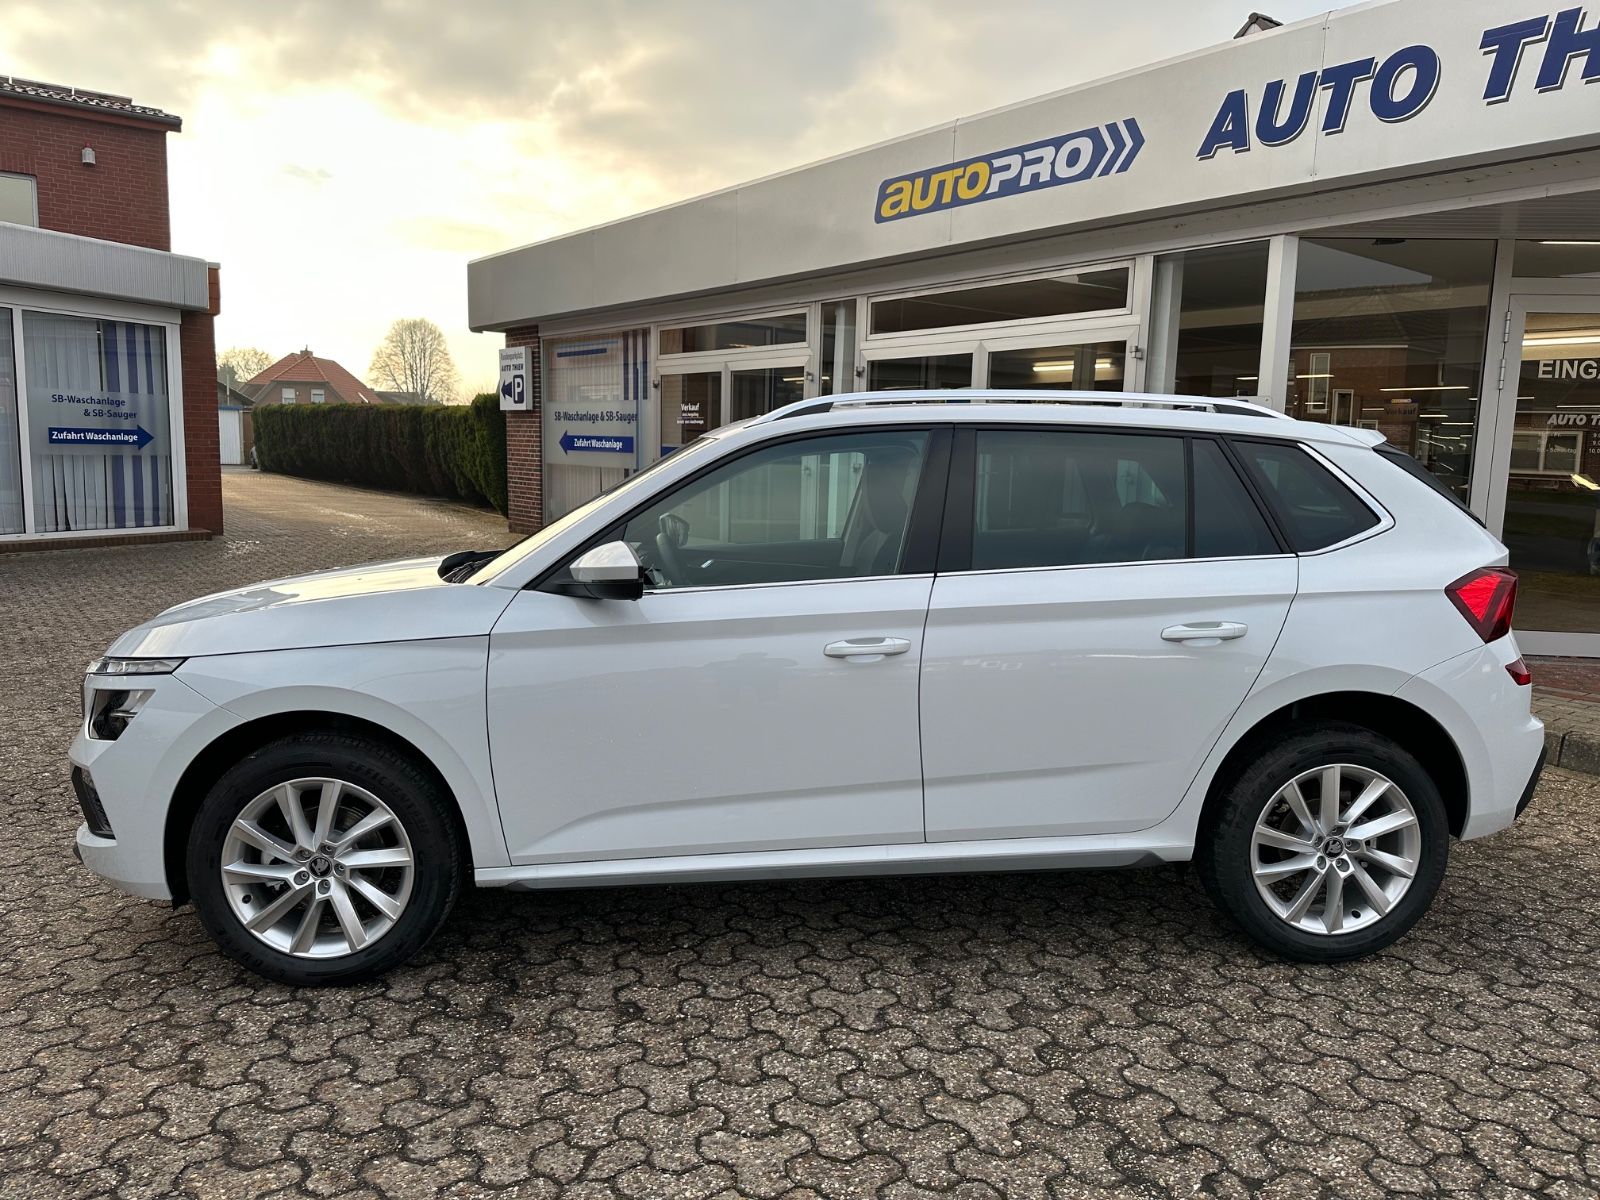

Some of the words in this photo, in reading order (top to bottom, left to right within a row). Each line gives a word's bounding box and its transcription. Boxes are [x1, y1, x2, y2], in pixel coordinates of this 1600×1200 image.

[1196, 44, 1440, 160] AUTO
[1538, 360, 1600, 379] EING
[514, 377, 523, 401] P
[52, 394, 126, 407] SB-Waschanlage
[680, 402, 700, 411] Verkauf
[84, 409, 90, 417] &
[92, 409, 137, 420] SB-Sauger
[554, 411, 599, 424] SB-Waschanlage
[600, 411, 604, 421] &
[605, 411, 639, 424] SB-Sauger
[1547, 414, 1587, 425] AUTO
[1591, 414, 1600, 425] T
[52, 431, 84, 440] Zufahrt
[86, 432, 138, 443] Waschanlage
[573, 438, 591, 447] Zufahrt
[591, 438, 623, 450] Waschanlage
